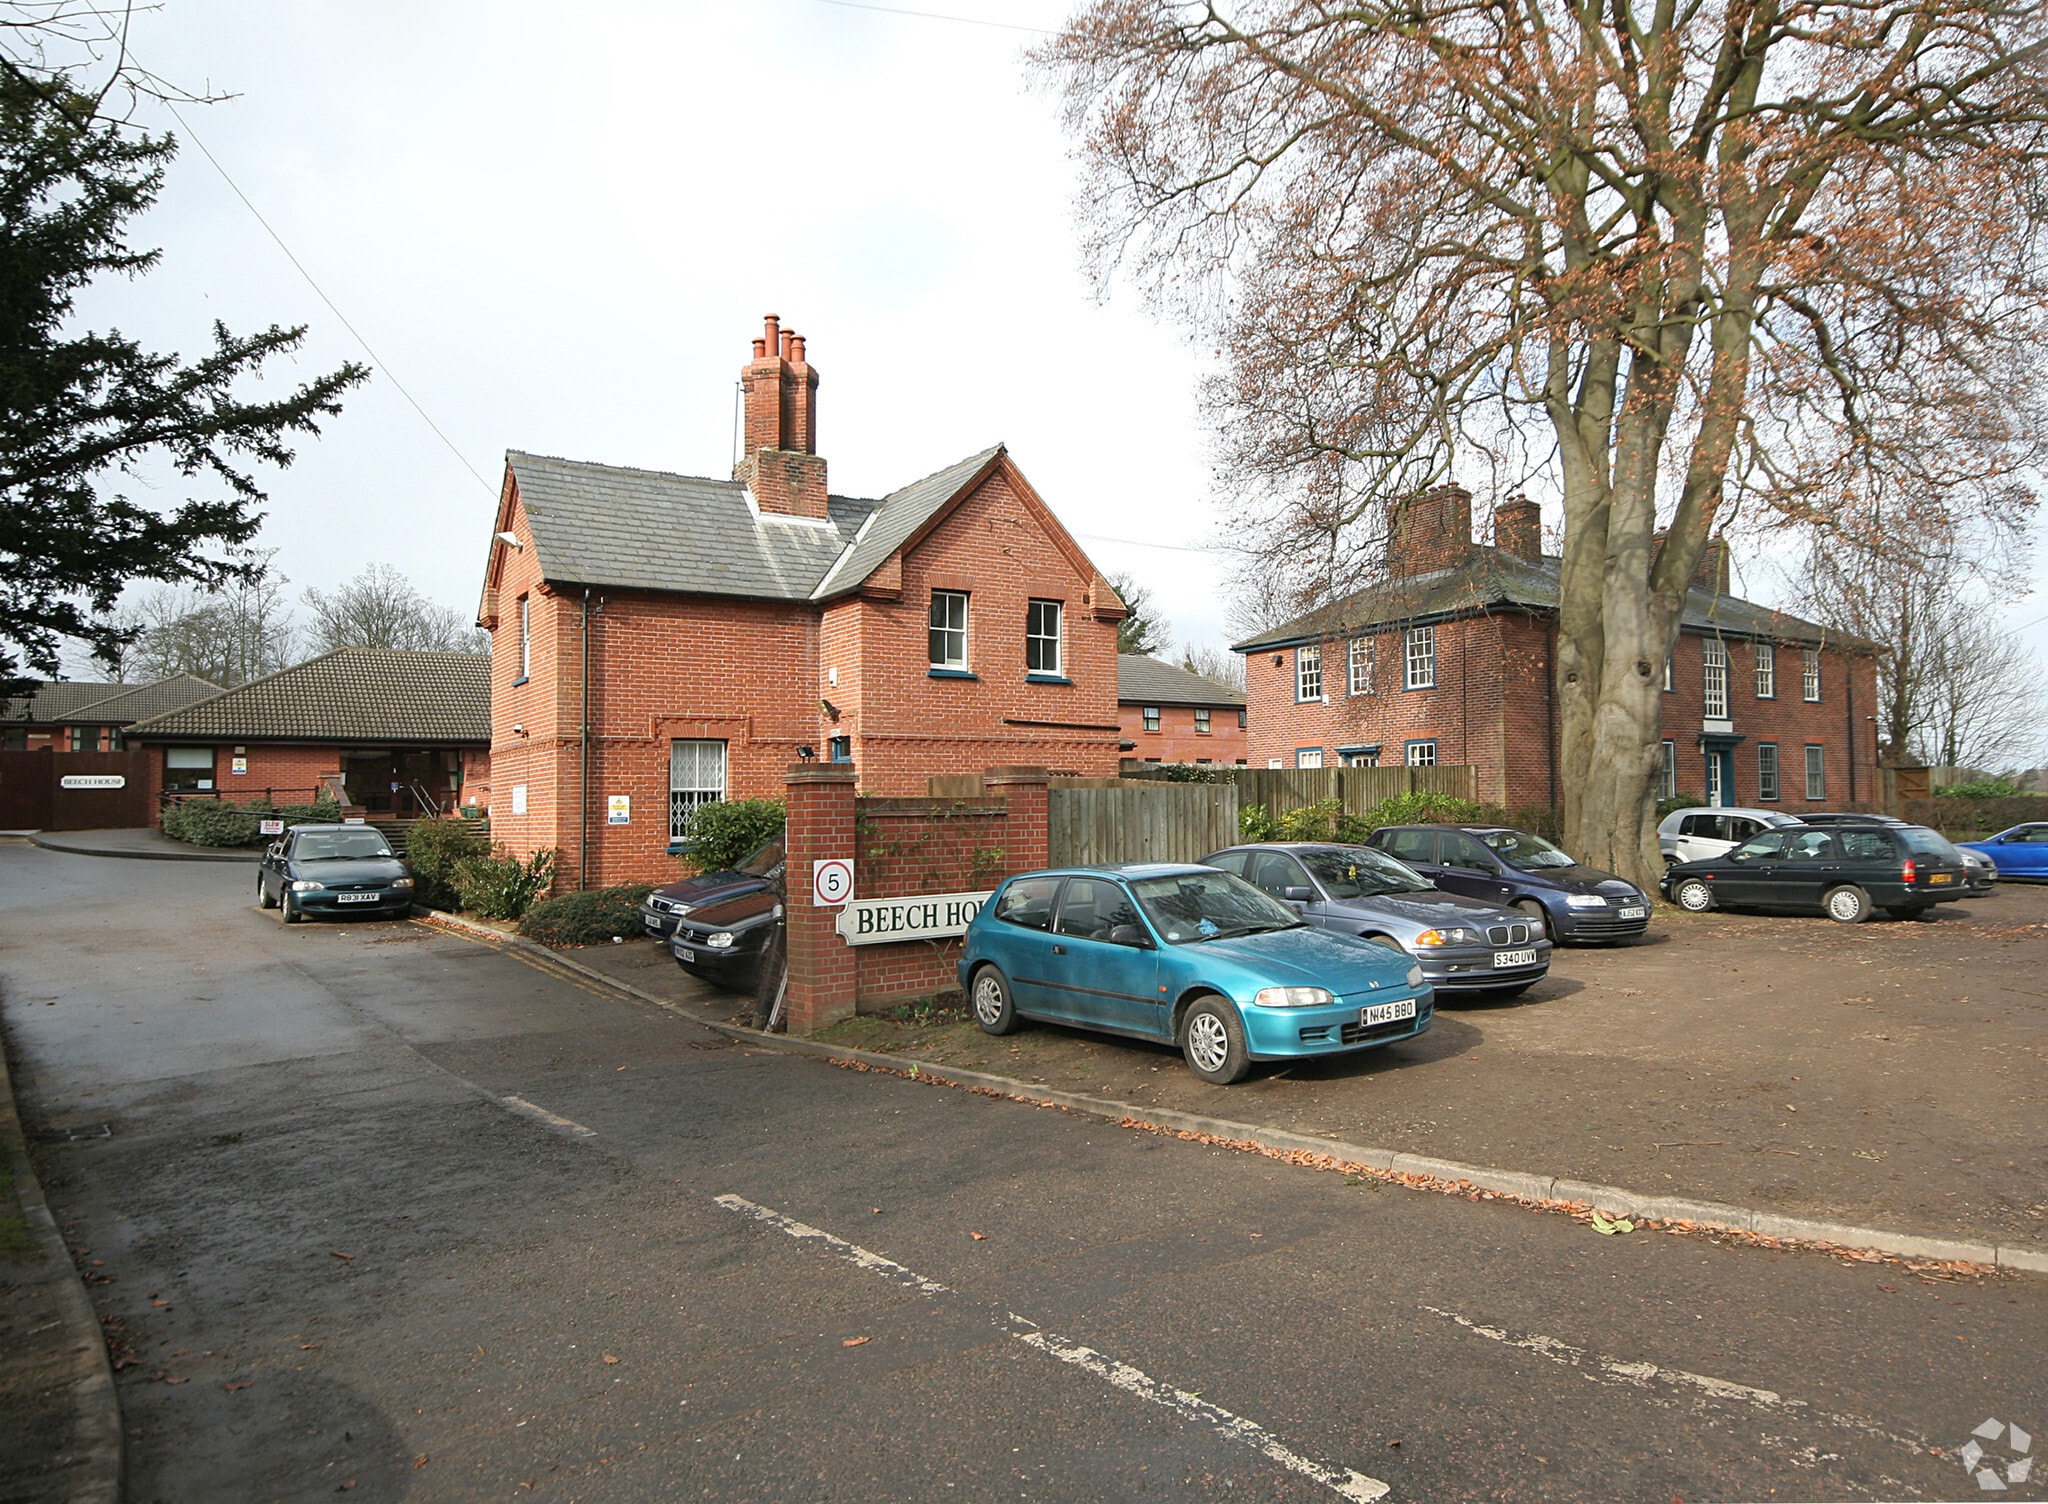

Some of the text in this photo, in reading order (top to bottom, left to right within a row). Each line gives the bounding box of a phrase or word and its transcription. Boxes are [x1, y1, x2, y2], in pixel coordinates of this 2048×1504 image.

[828, 873, 840, 892] 5
[856, 900, 984, 934] BEECH HO
[1496, 953, 1520, 965] S340
